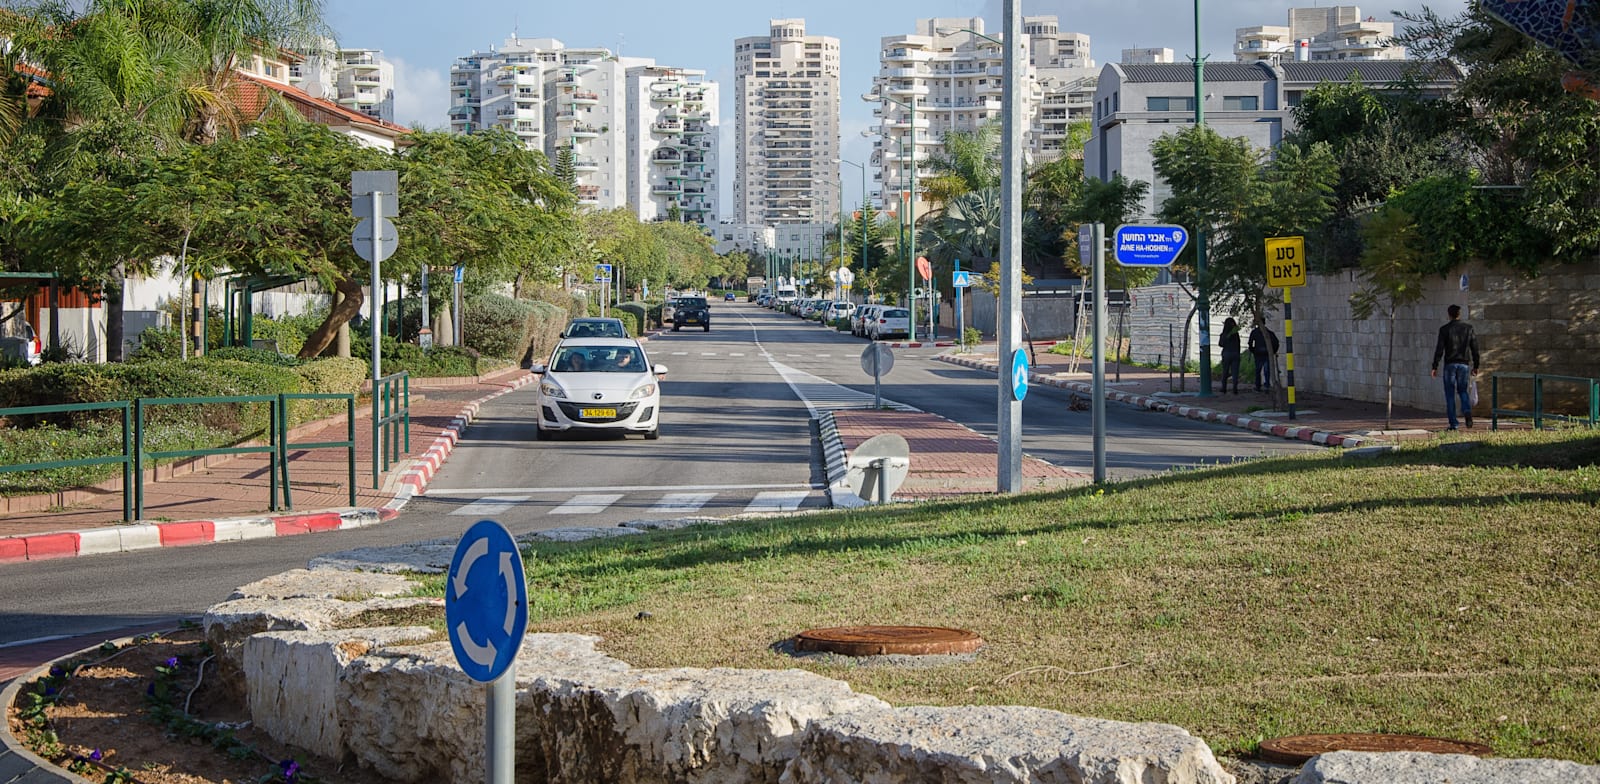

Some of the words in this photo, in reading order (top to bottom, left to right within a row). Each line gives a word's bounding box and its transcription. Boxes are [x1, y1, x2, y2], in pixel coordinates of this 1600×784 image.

[1122, 233, 1145, 243] החושן
[1147, 233, 1165, 242] אבני
[1276, 247, 1295, 260] סע
[1272, 262, 1300, 278] לאט
